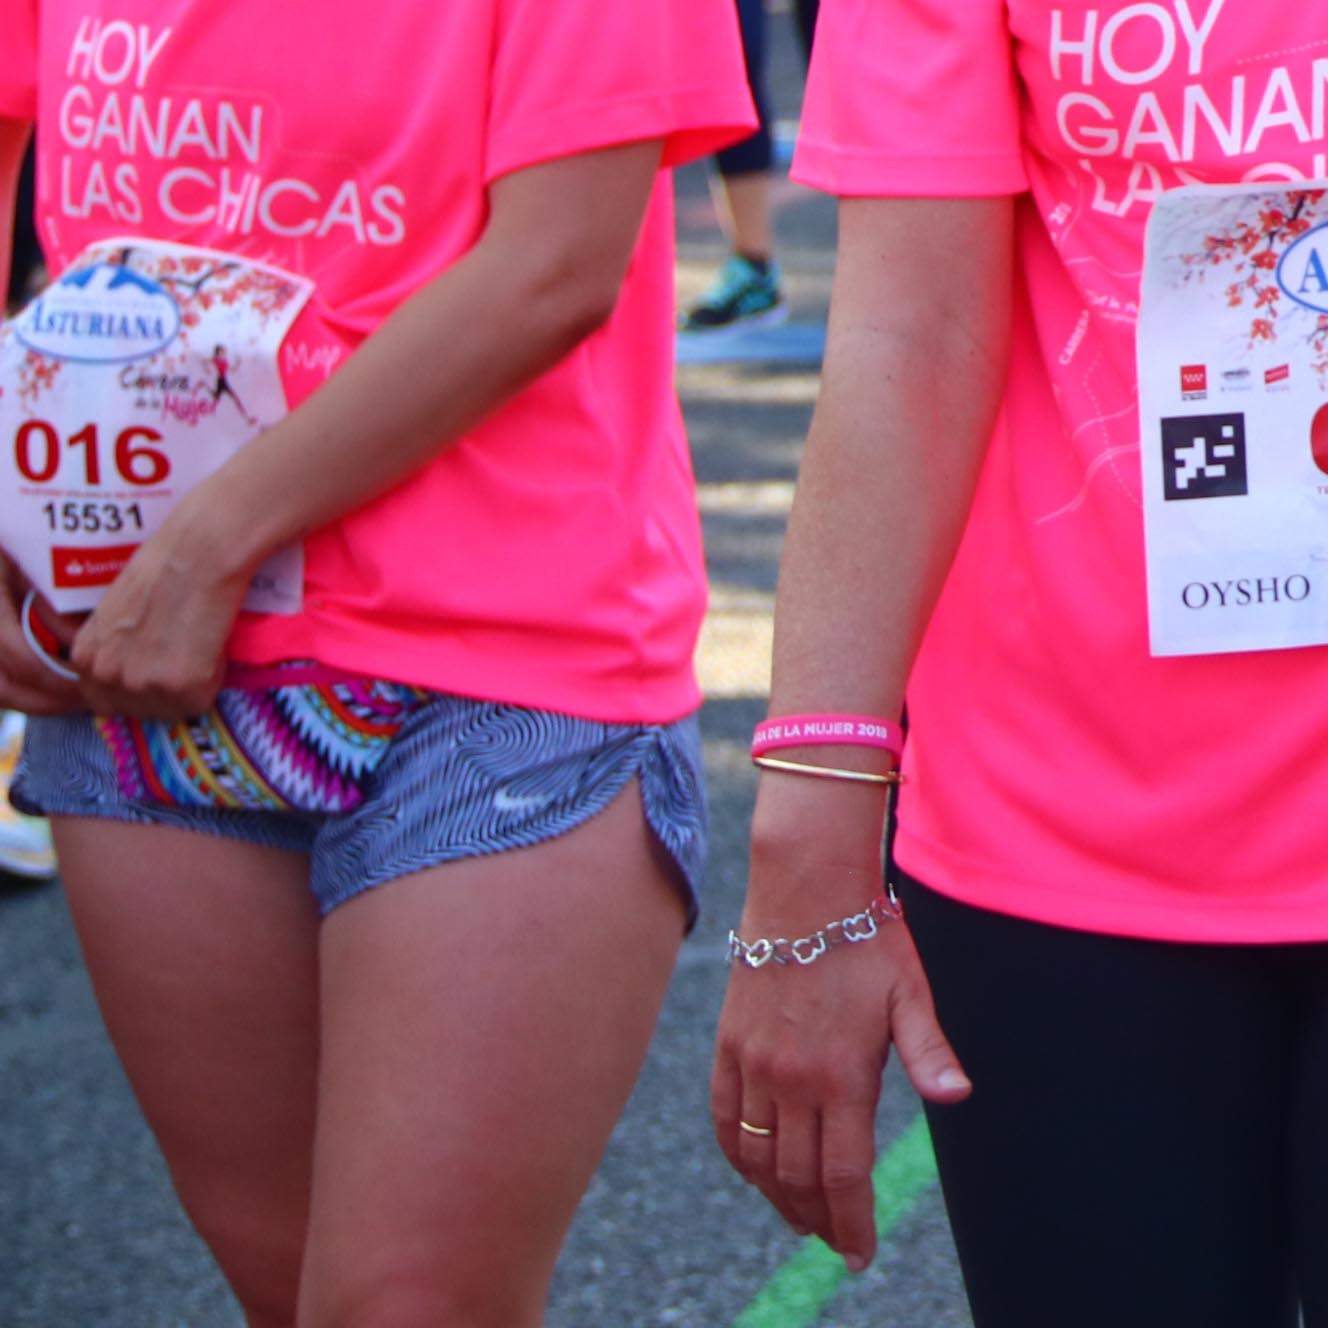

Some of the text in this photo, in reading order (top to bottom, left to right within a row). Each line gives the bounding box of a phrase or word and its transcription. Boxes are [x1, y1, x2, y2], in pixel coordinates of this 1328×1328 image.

[66, 16, 171, 87] HOY
[59, 85, 263, 164] GANAN
[60, 155, 408, 247] LAS CHICAS
[30, 300, 165, 341] ASTURIANA
[13, 418, 172, 487] 016
[42, 501, 144, 533] 15531
[1180, 573, 1312, 610] OYSHO
[783, 723, 801, 738] LA
[803, 722, 854, 736] MUJER
